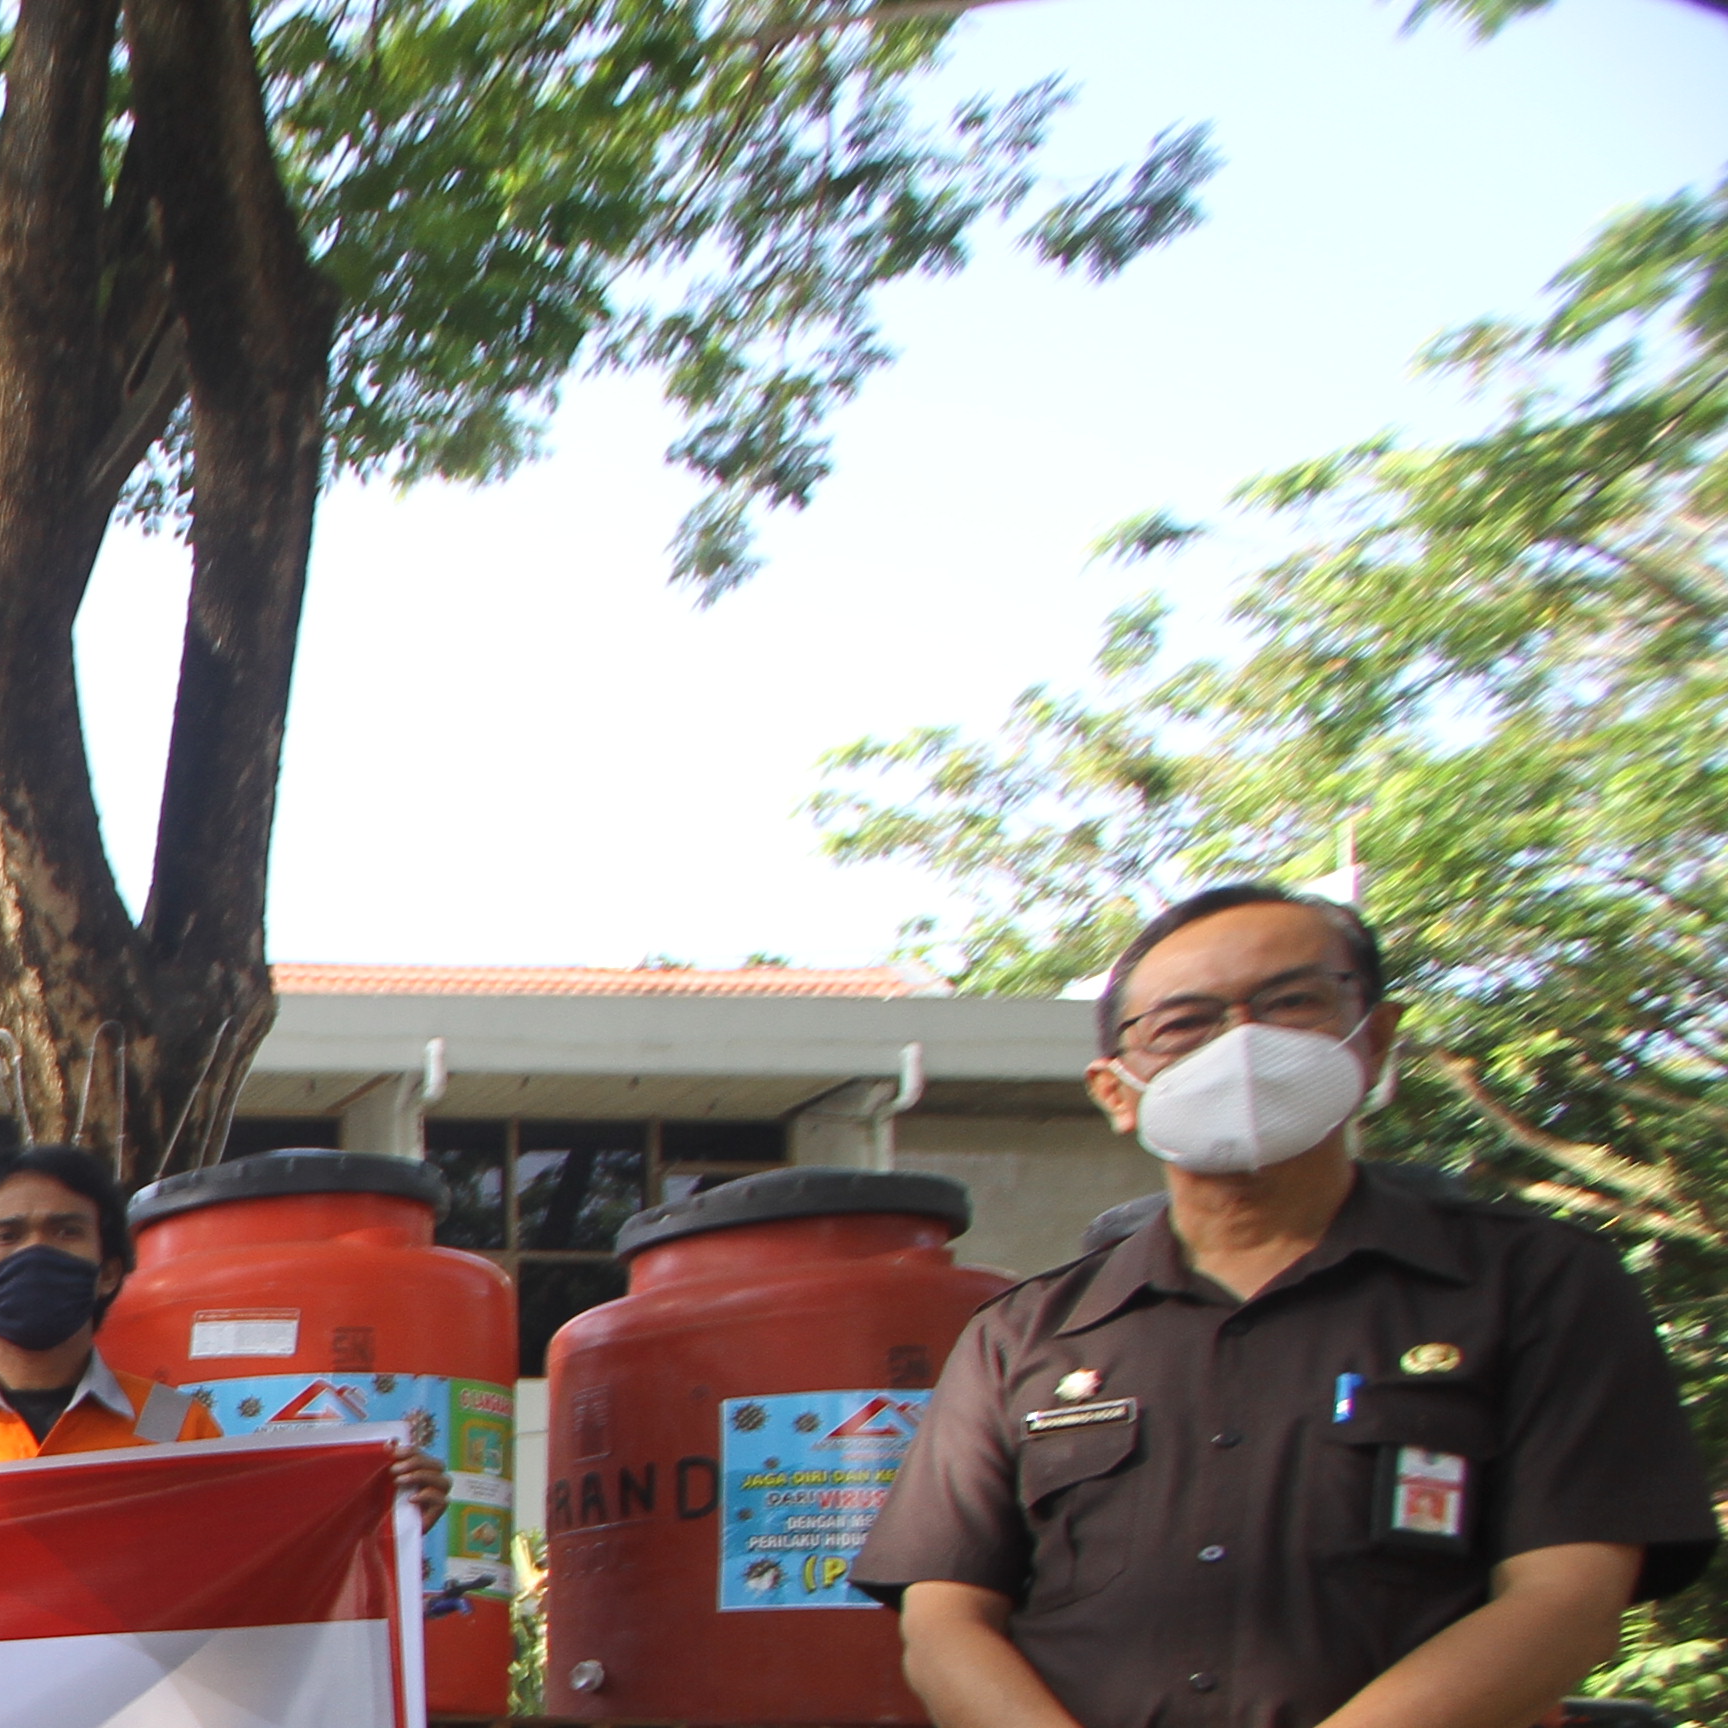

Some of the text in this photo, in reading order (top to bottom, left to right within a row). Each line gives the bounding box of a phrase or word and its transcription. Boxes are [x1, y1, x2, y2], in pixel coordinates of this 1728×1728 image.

[742, 1473, 787, 1489] JAGA
[793, 1470, 827, 1485] DIRI
[832, 1469, 870, 1483] DAN
[766, 1490, 814, 1507] DARI
[787, 1514, 845, 1529] DENGAN
[748, 1535, 821, 1551] PERILAKU
